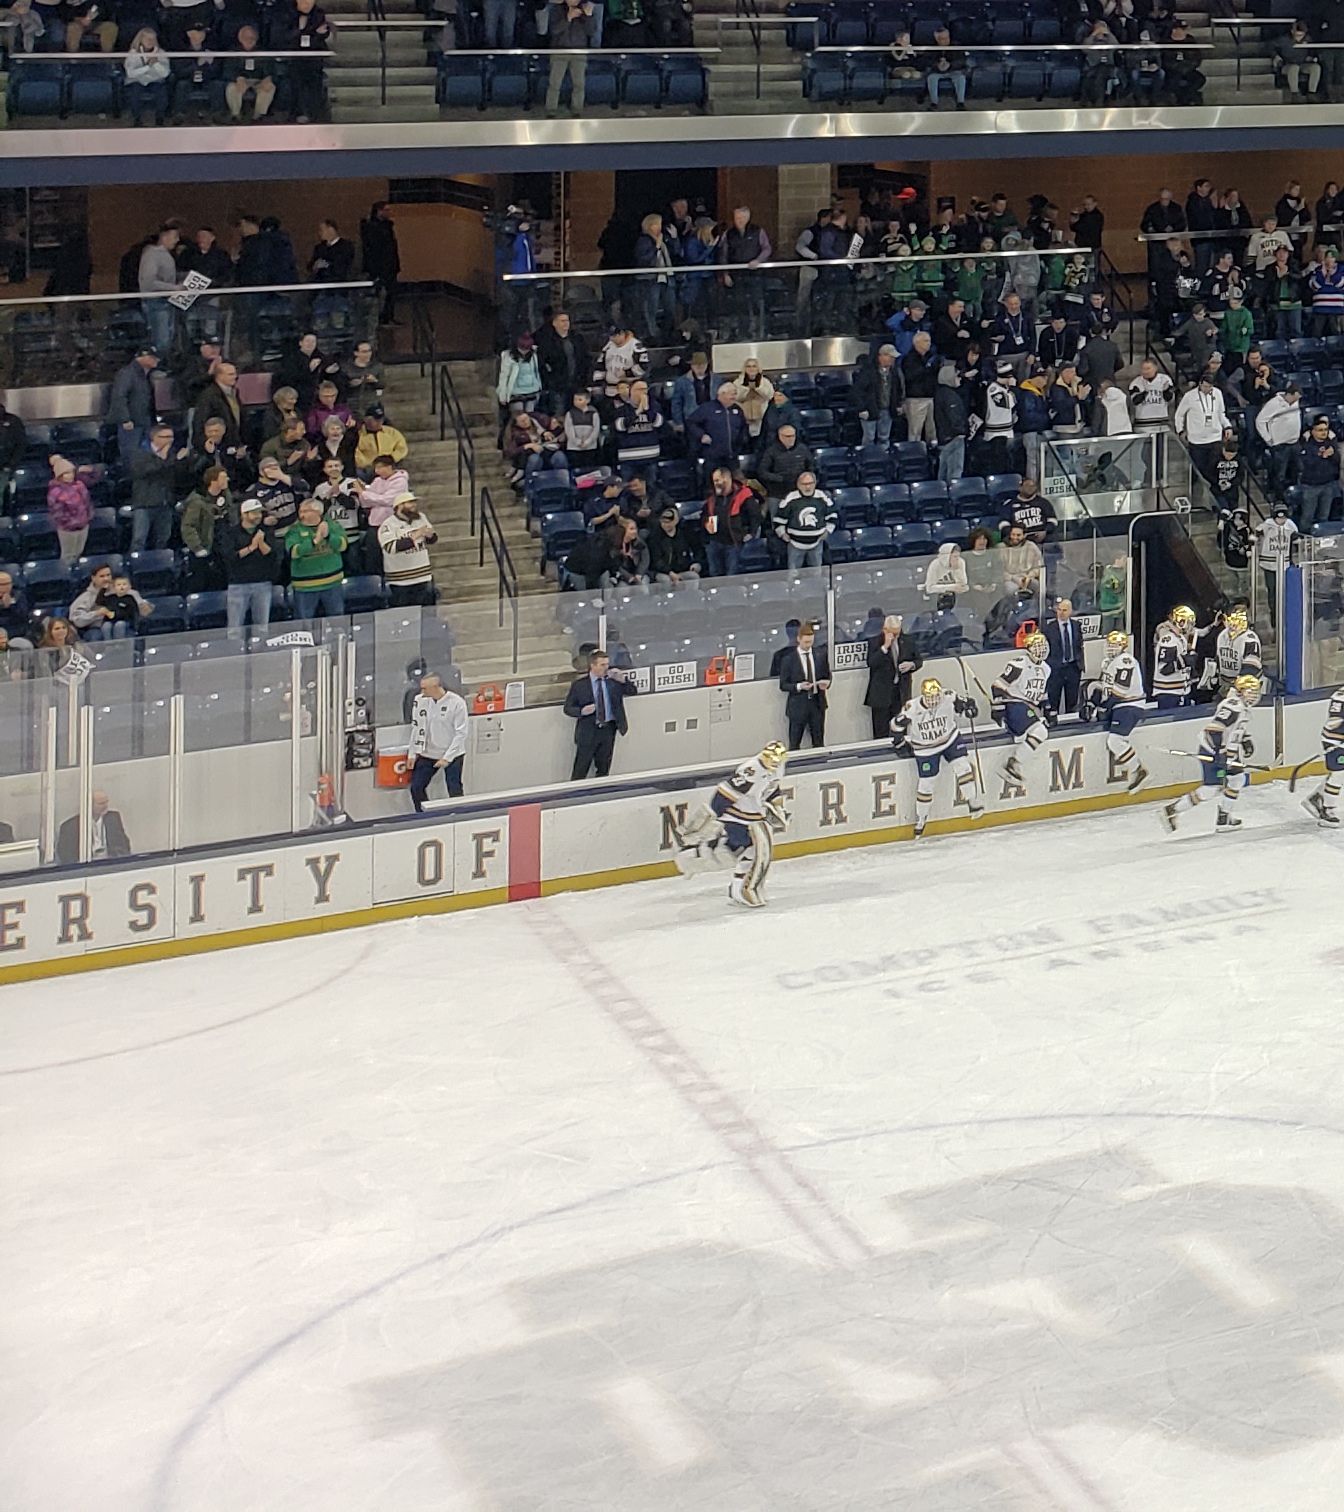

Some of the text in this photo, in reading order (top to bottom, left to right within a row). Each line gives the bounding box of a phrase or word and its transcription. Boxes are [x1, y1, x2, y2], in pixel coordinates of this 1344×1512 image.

[1052, 478, 1065, 487] GO
[669, 665, 684, 674] GO
[658, 674, 694, 685] IRISH!
[394, 761, 406, 774] G
[416, 829, 501, 887] OF
